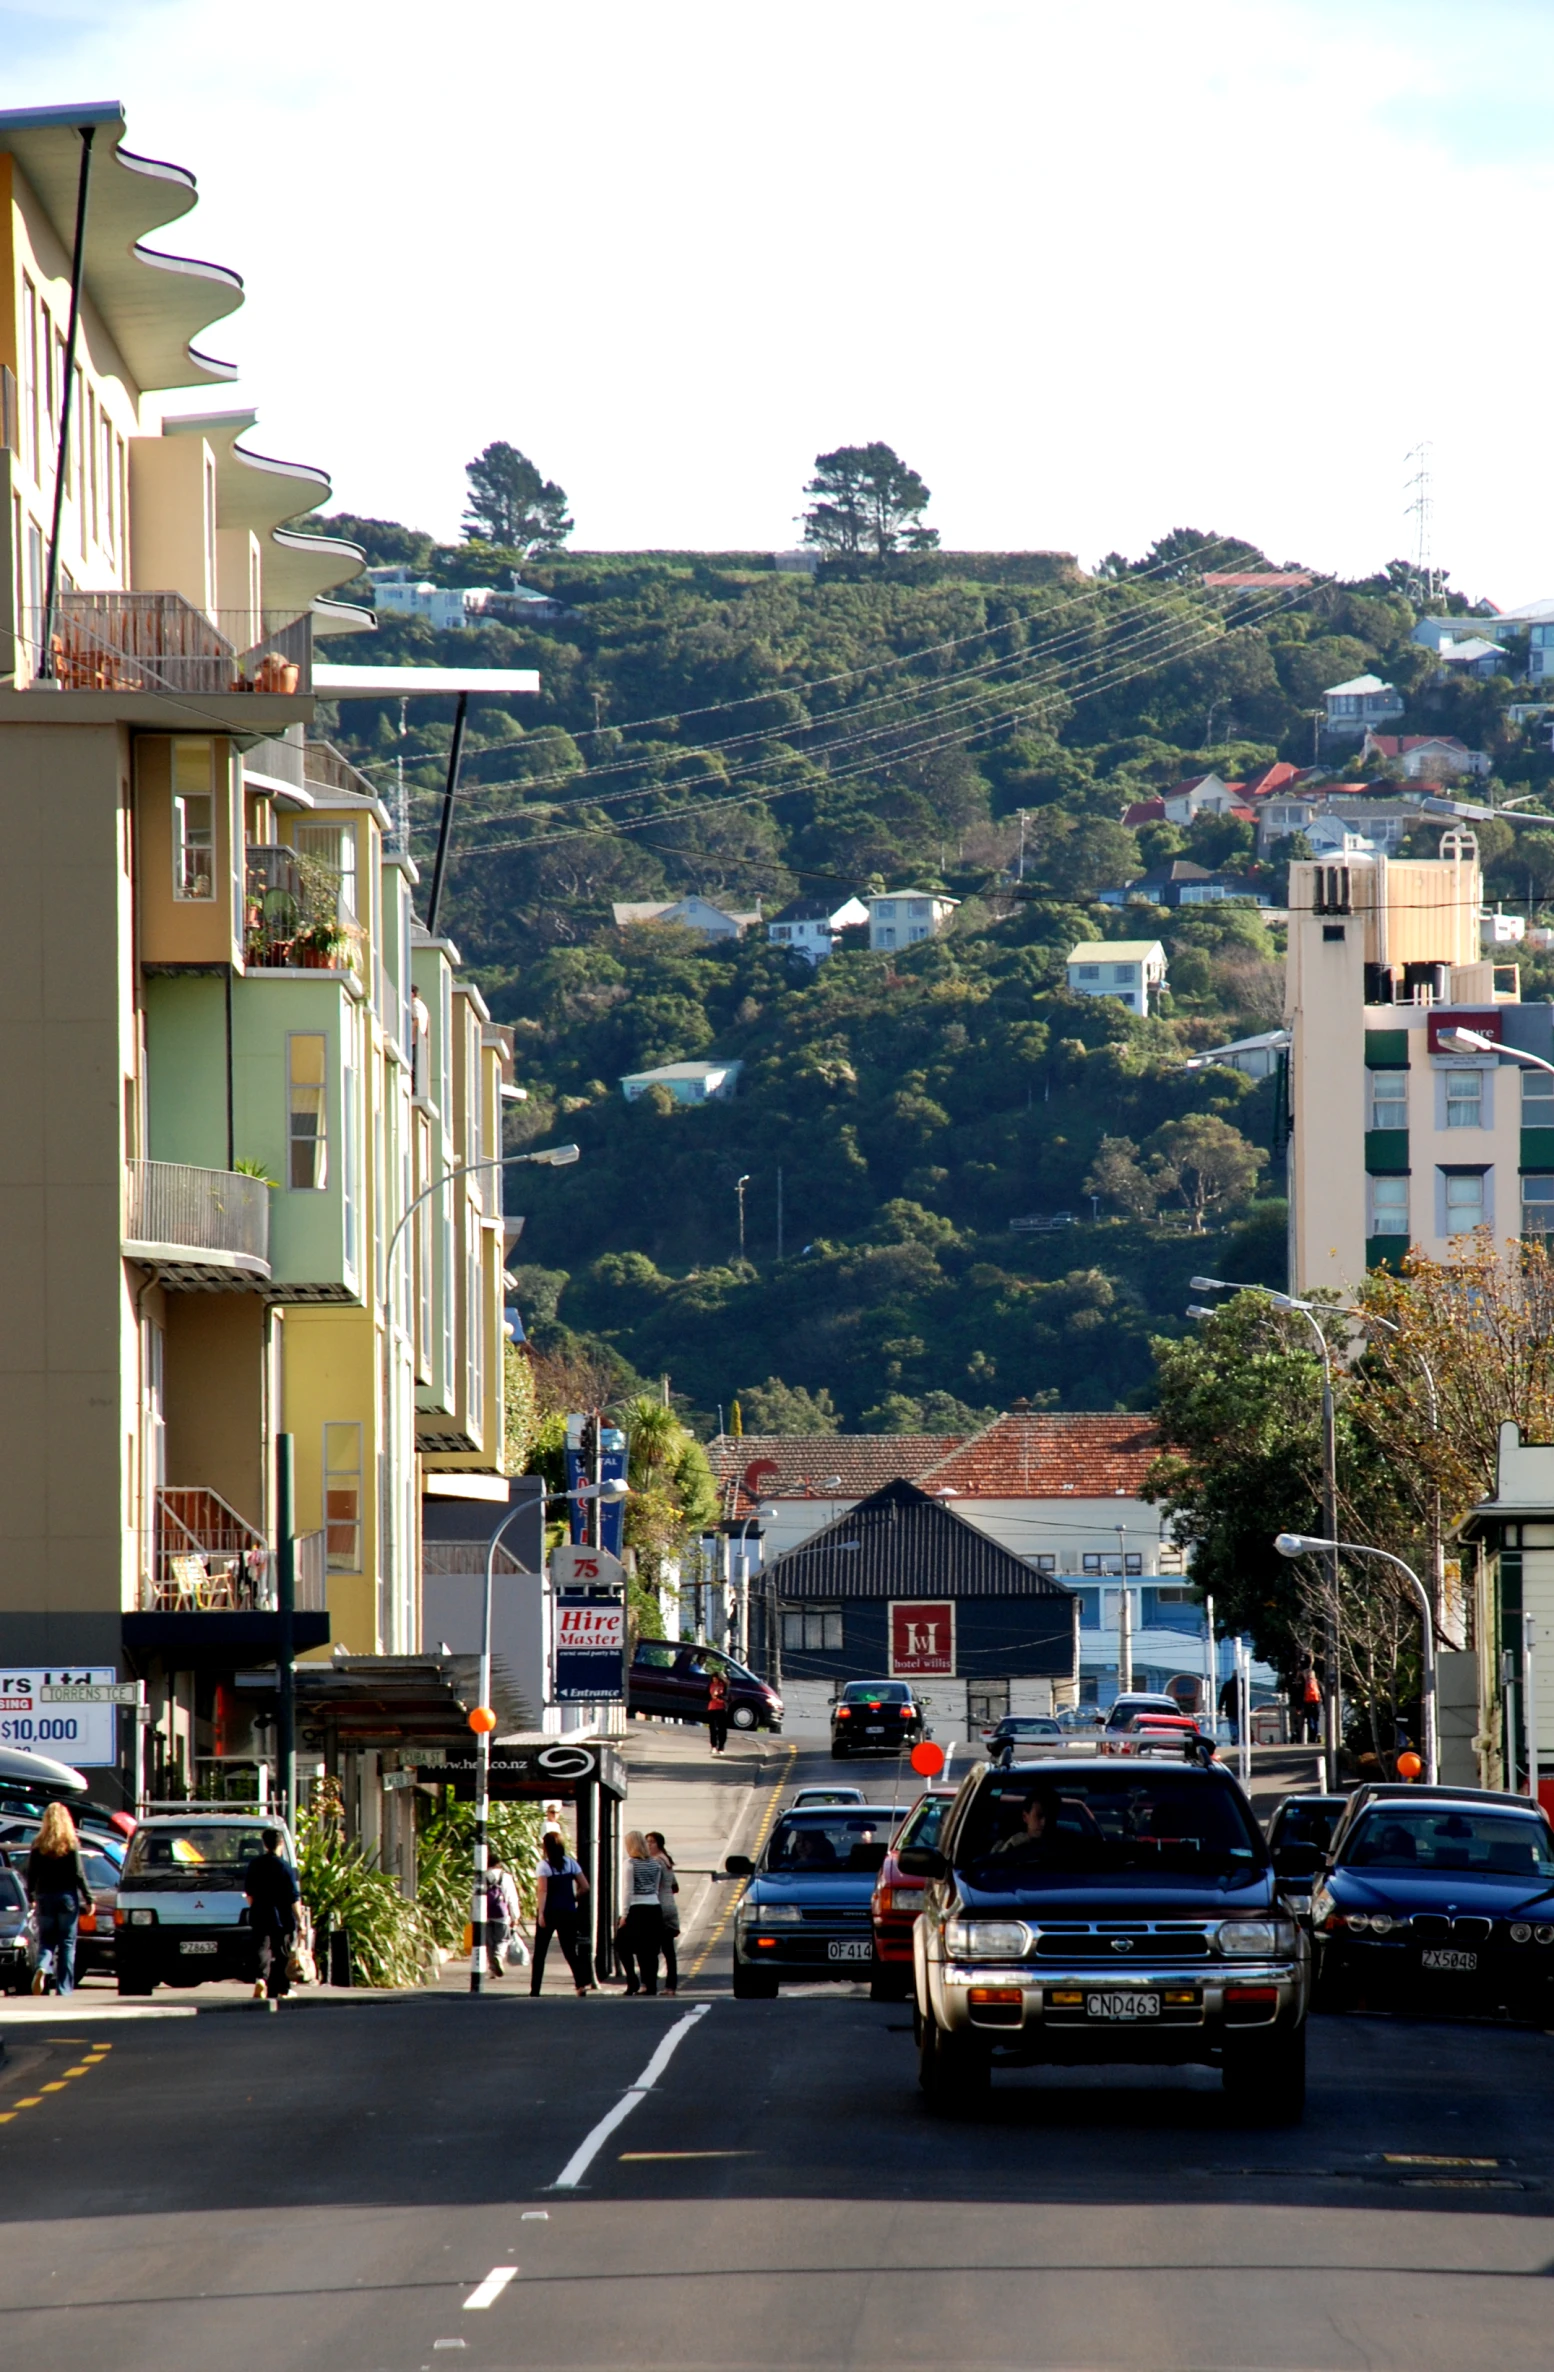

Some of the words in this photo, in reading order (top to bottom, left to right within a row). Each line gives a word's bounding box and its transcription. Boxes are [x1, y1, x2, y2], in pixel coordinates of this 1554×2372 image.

[573, 1558, 600, 1578] 75
[560, 1610, 621, 1631] Hire
[558, 1632, 620, 1646] Master
[894, 1658, 920, 1668] hotel
[923, 1657, 951, 1668] willis
[49, 1687, 101, 1700] TORRENS
[106, 1687, 127, 1700] TCE
[570, 1688, 620, 1698] Entrance
[1, 1718, 78, 1742] $10,000
[404, 1752, 427, 1762] CUBA
[431, 1752, 441, 1762] ST
[1422, 1950, 1477, 1969] ZX5048
[1088, 1995, 1159, 2015] CND463
